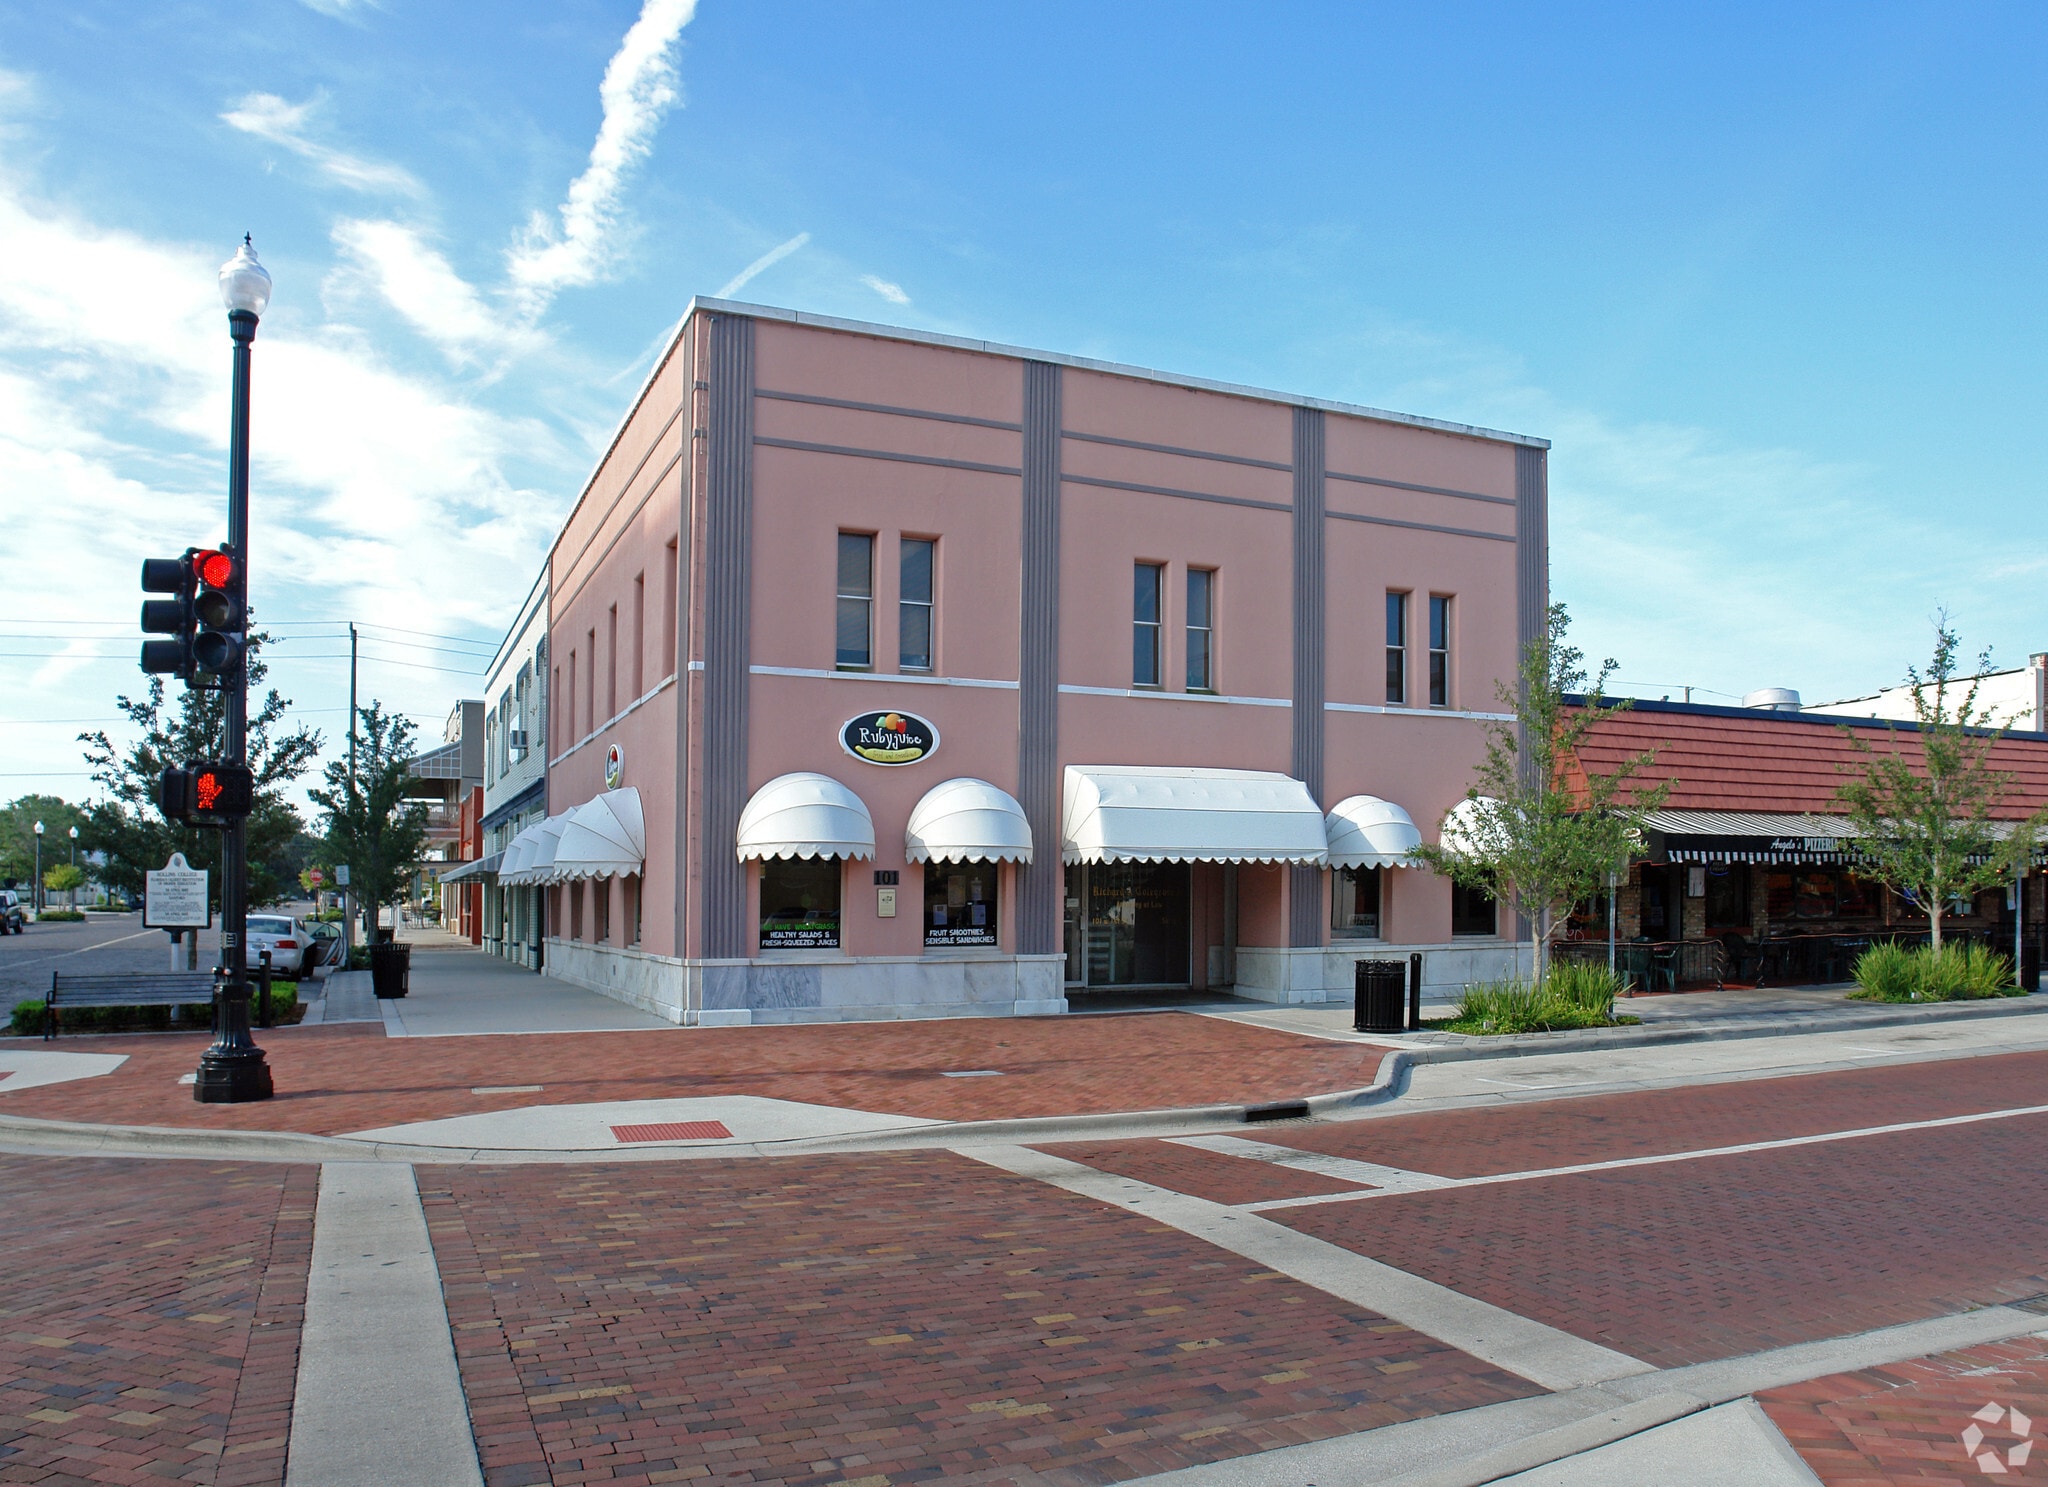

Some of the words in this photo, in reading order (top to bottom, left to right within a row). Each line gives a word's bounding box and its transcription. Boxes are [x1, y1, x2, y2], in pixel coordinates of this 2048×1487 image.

[859, 727, 921, 749] Rubyjuice
[1770, 837, 1801, 852] Angelo's
[875, 871, 898, 884] 101
[949, 928, 985, 936] SMOOTHIES
[925, 937, 955, 945] SENSIBLE
[956, 936, 995, 944] SANDWICHES
